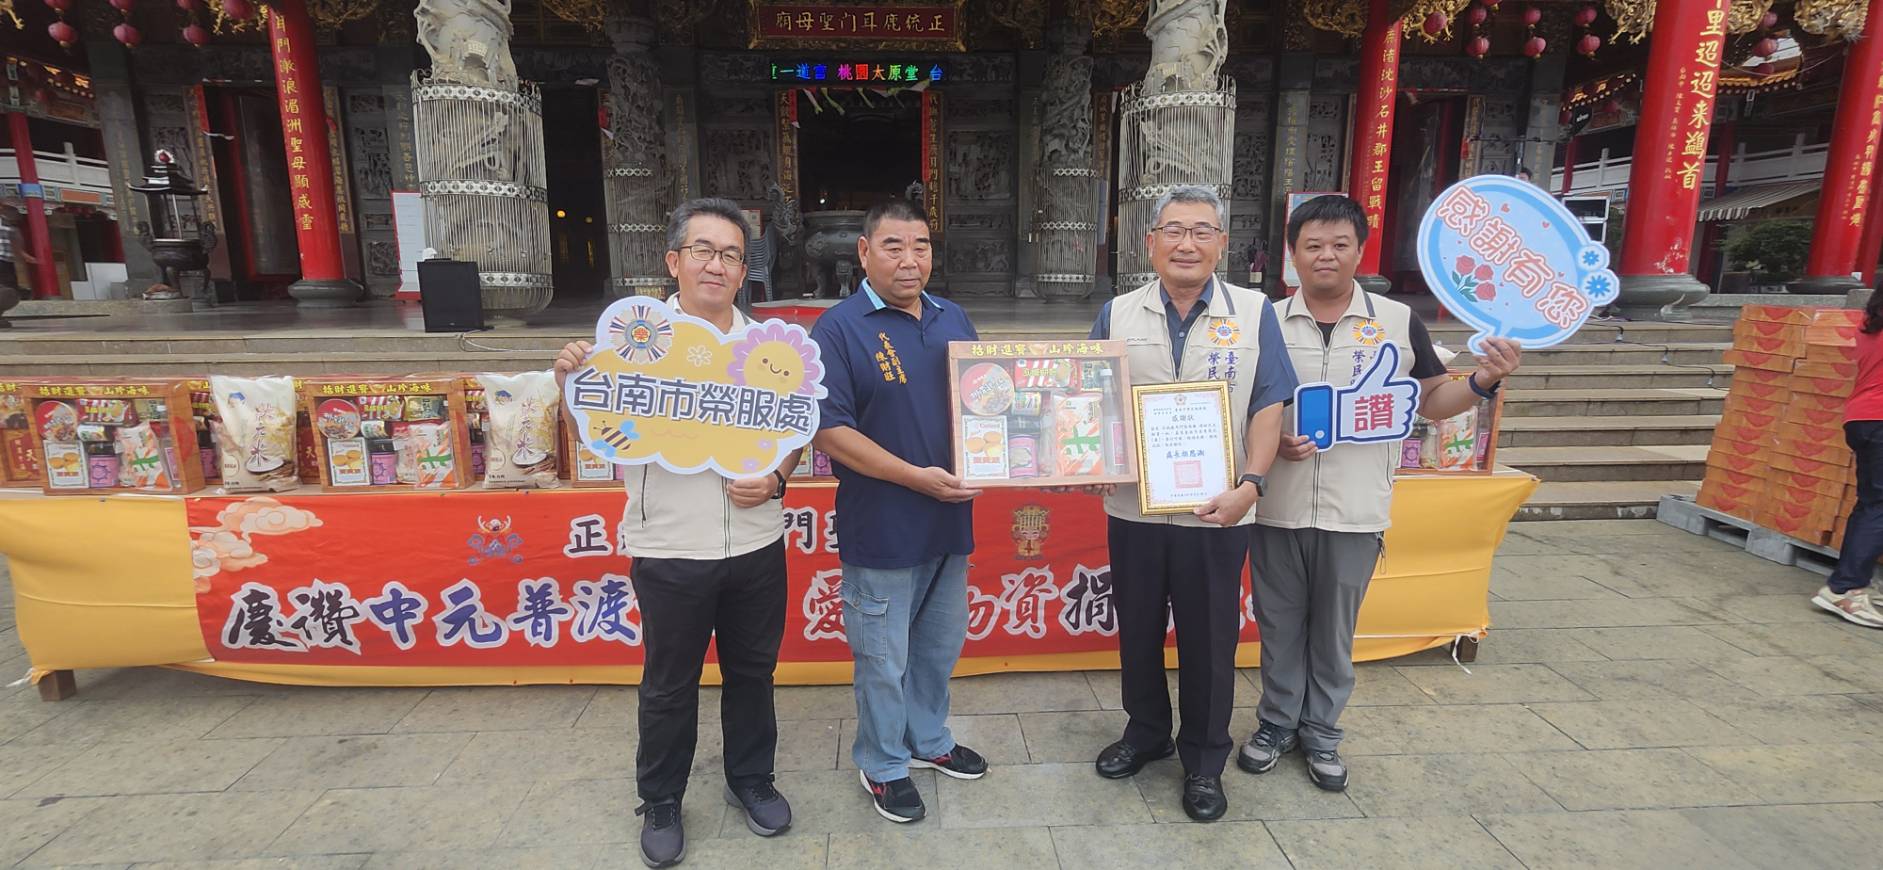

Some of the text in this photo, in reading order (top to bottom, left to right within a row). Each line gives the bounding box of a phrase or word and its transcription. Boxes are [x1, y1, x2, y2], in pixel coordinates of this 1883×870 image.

[1436, 185, 1589, 330] 感謝有您
[1049, 342, 1104, 355] 山珍海味
[1350, 349, 1366, 385] 榮民
[573, 367, 815, 436] 台南市榮服處
[1354, 392, 1395, 433] 讚
